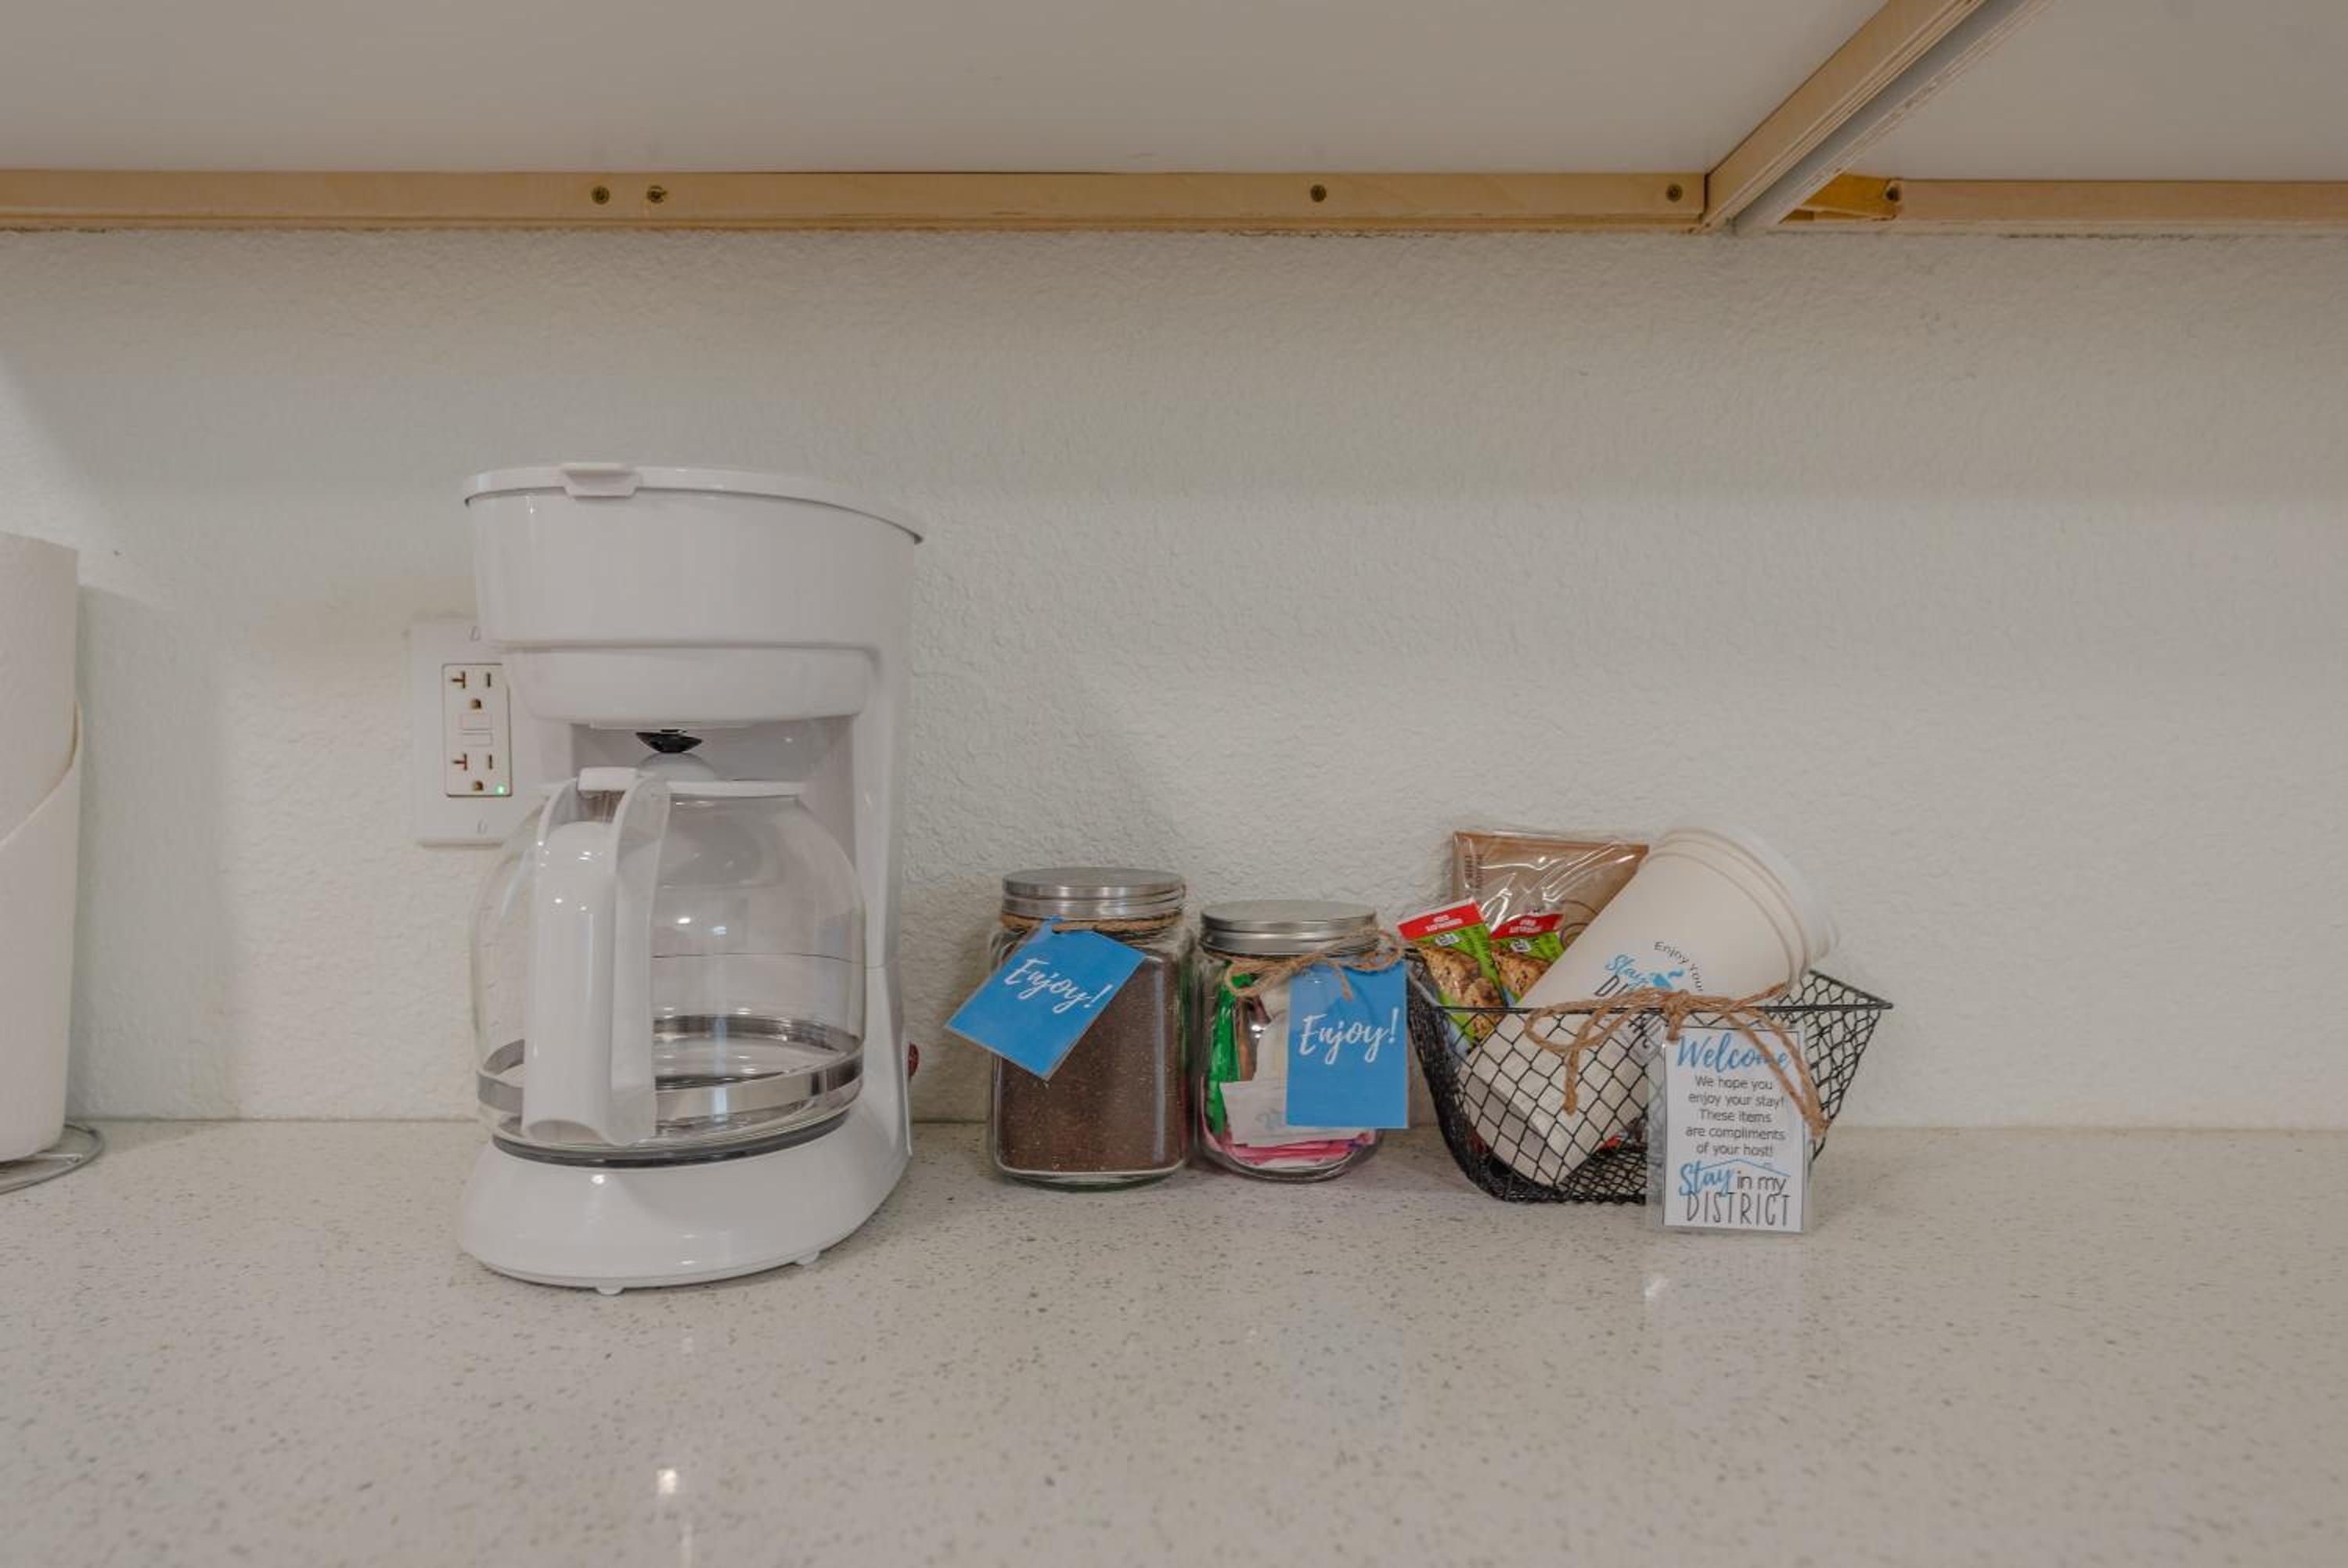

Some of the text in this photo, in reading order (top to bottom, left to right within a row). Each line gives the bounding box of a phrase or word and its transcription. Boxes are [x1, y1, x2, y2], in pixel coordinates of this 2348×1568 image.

[1654, 941, 1690, 964] Enjoy
[1003, 957, 1113, 1014] Enjoy!
[1298, 1007, 1401, 1065] Enjoy!
[1694, 1076, 1773, 1092] We hope you
[1688, 1092, 1784, 1109] enjoy your stay!
[1700, 1109, 1773, 1123] These items
[1685, 1127, 1787, 1141] are compliments
[1696, 1142, 1774, 1157] of your host!
[1678, 1160, 1787, 1198] Stay in my
[1687, 1190, 1792, 1227] DISTRICT
